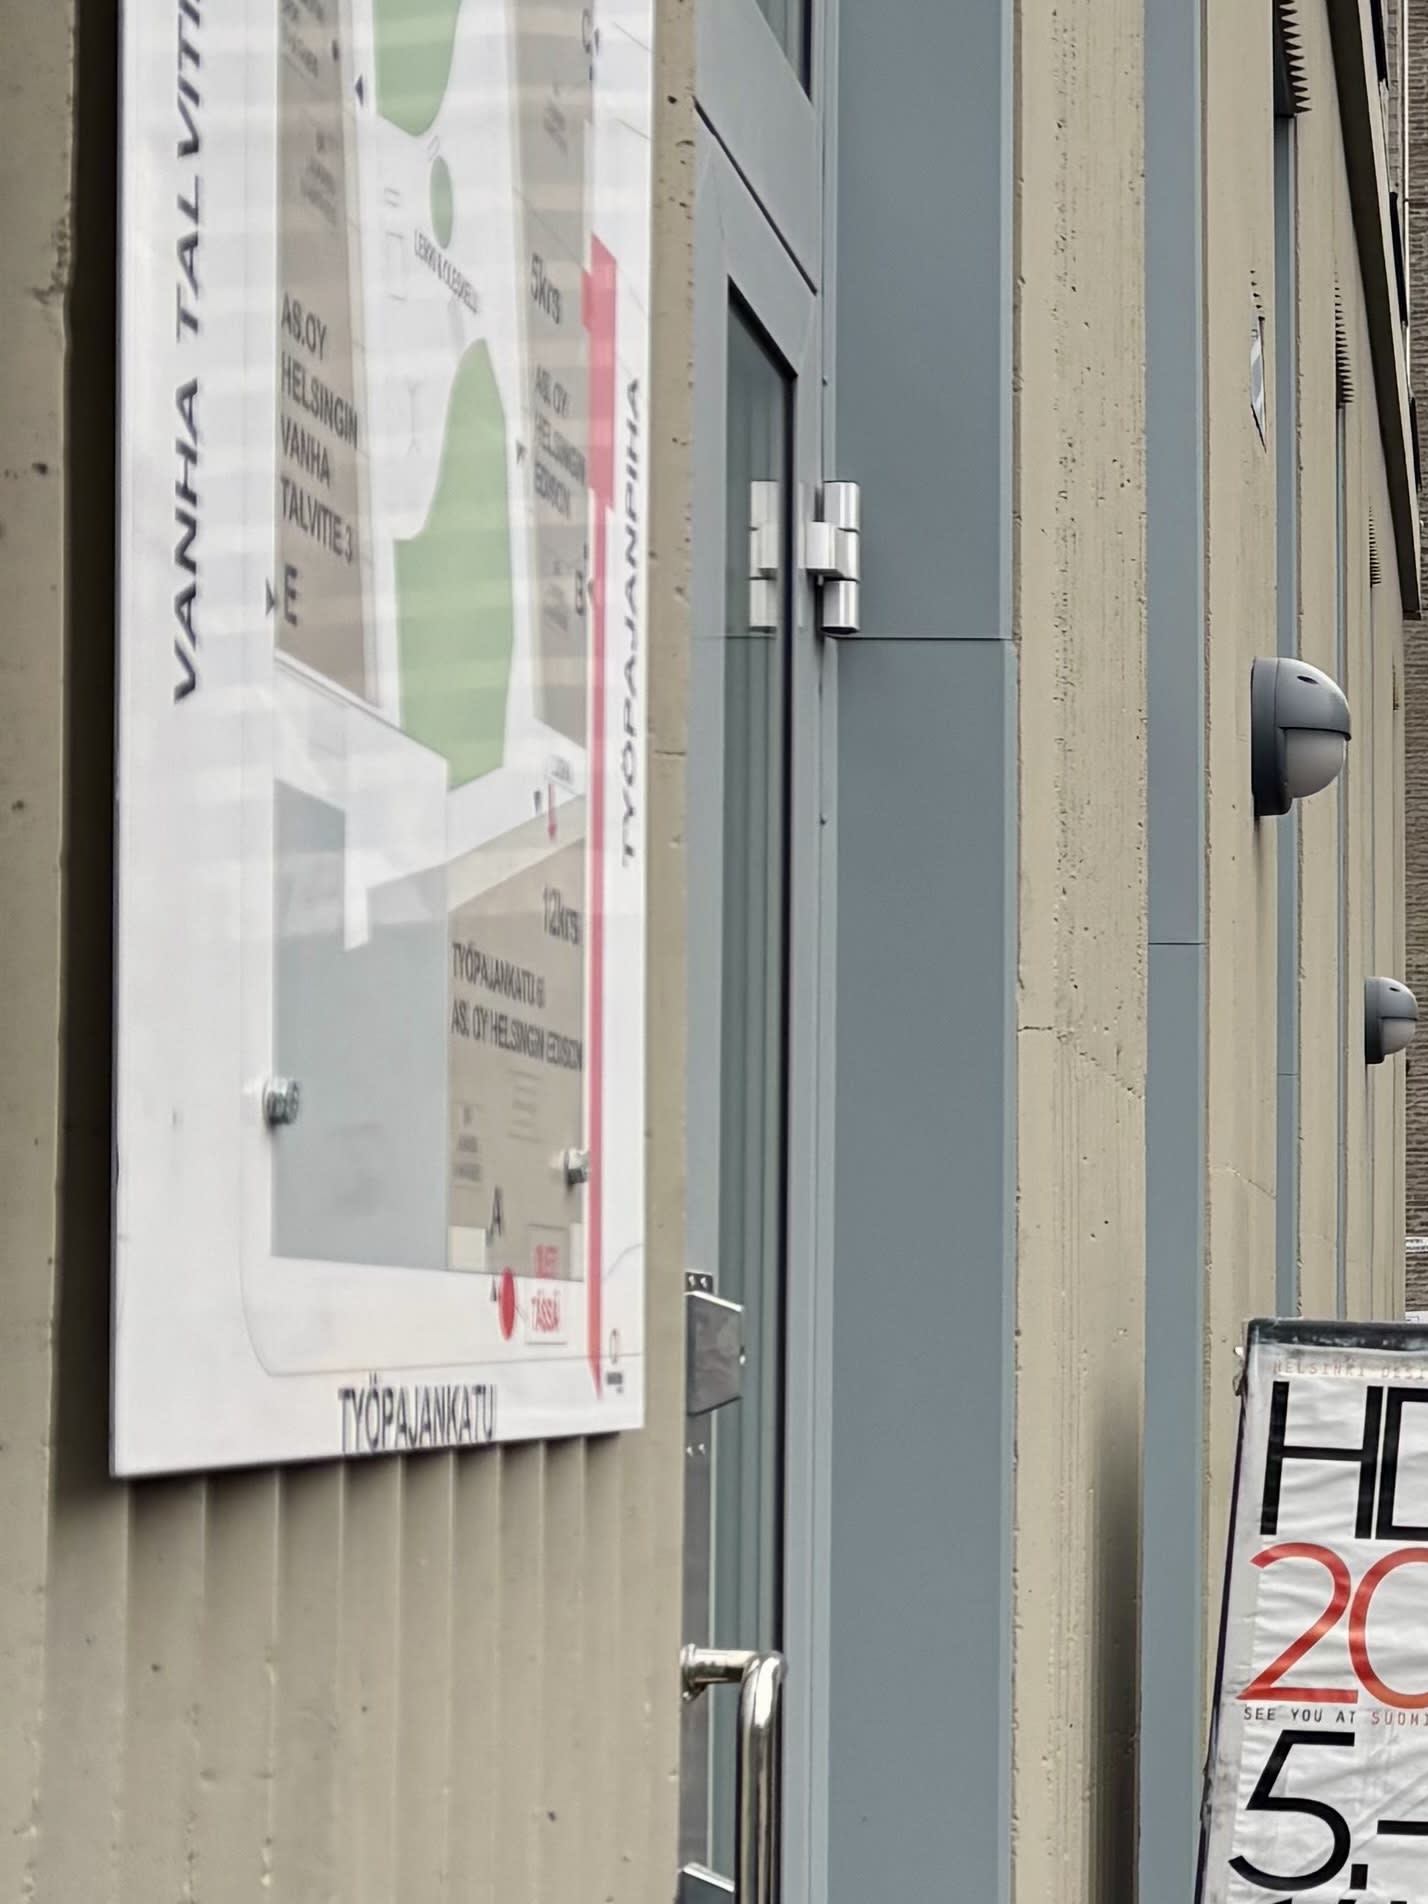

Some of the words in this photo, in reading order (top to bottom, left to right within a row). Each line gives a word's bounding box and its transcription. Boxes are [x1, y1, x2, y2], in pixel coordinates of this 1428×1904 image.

[281, 287, 327, 365] AS.OY
[281, 348, 357, 451] HELSINGIN
[281, 412, 330, 488] VANHA
[173, 378, 199, 703] VANHA
[280, 473, 343, 559] TALVITIE
[284, 562, 297, 626] E
[621, 378, 640, 867] TYÖPAJANPIHA
[490, 1186, 502, 1236] A
[338, 1372, 498, 1454] TYÖPAJANKATU
[1243, 1706, 1276, 1721] SEE
[1291, 1708, 1323, 1723] YOU
[1336, 1711, 1355, 1726] AT
